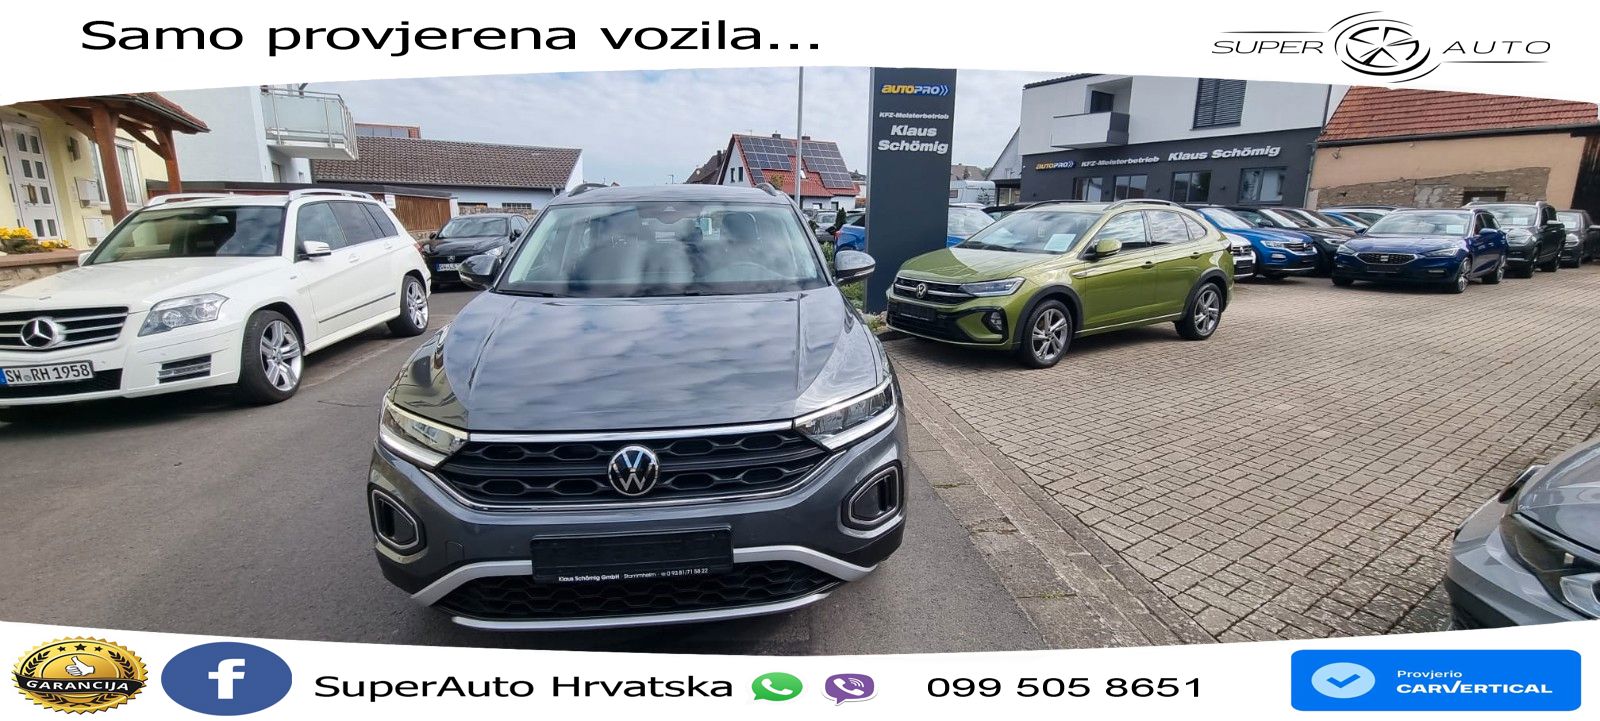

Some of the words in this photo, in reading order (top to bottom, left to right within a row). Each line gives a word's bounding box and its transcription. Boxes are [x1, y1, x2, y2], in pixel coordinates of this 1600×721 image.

[879, 111, 949, 120] KFZ-Meisterbetrieb
[890, 124, 937, 137] Klaus
[877, 139, 949, 154] Schömig
[1168, 151, 1208, 161] Klaus
[1211, 145, 1281, 159] Schömig
[1080, 156, 1160, 167] KFZ-Meisterbetrieb
[5, 369, 23, 383] SW
[30, 367, 51, 381] RH
[52, 364, 90, 380] 1958
